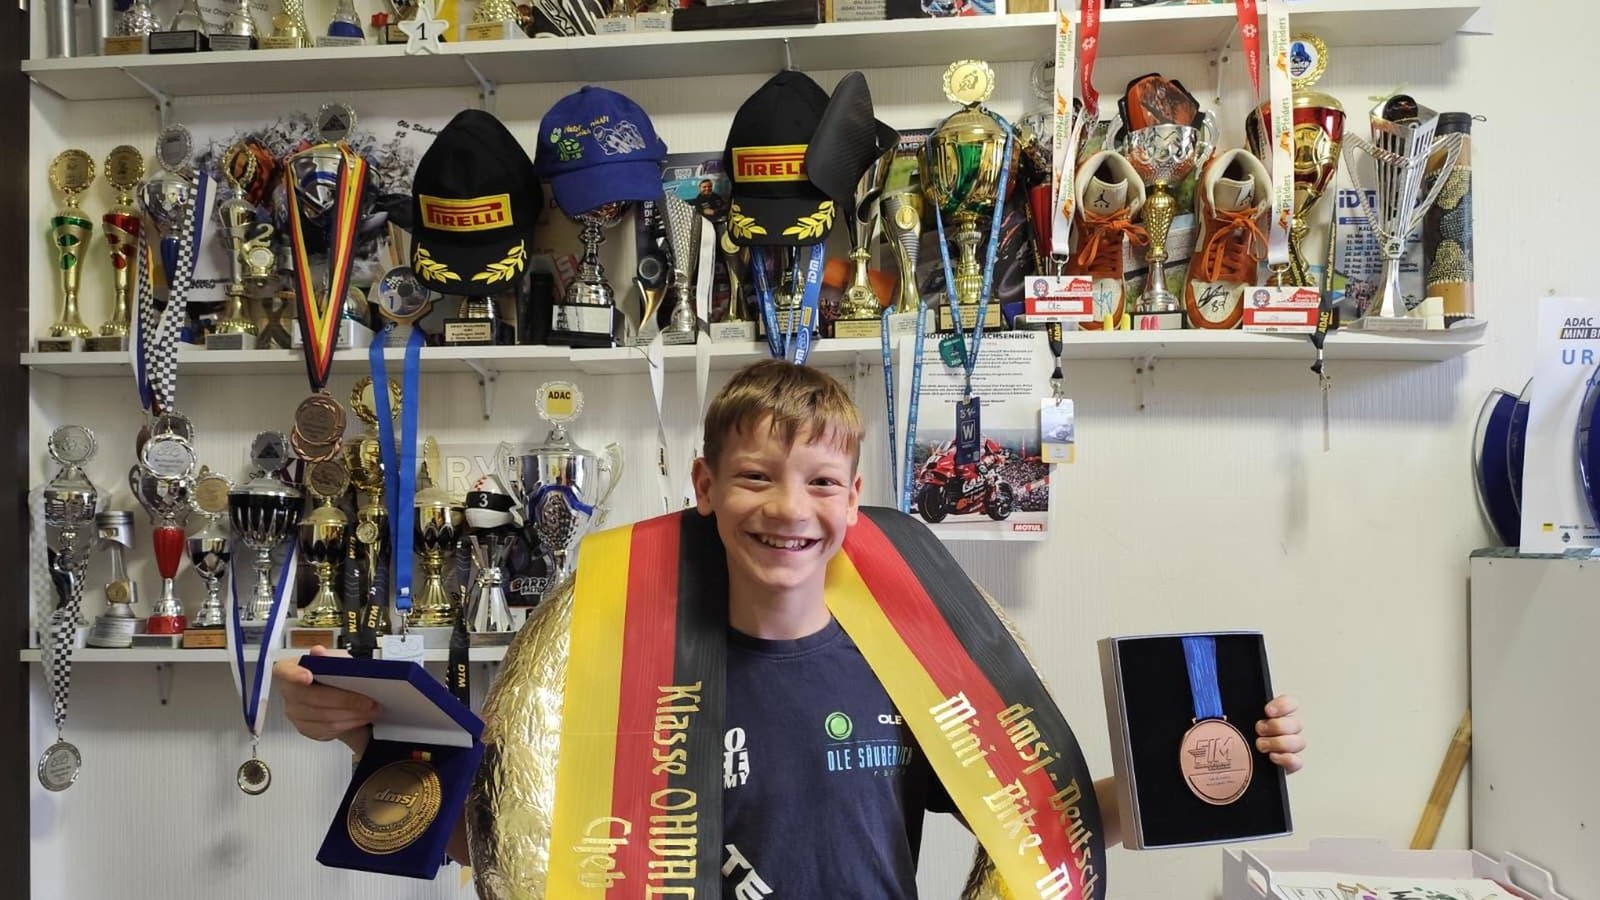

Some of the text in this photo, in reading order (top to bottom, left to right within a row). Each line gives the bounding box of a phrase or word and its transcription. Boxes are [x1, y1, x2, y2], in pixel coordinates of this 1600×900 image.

[416, 22, 428, 40] 1
[427, 201, 504, 228] PIRELLI
[1319, 312, 1329, 333] ADAC
[1564, 317, 1593, 327] ADAC
[982, 332, 1035, 340] ACHSENRING
[1563, 329, 1587, 338] MINI
[1562, 349, 1594, 365] UR
[548, 391, 571, 400] ADAC
[962, 424, 974, 440] W
[479, 494, 488, 507] 3
[348, 611, 356, 633] DTM
[368, 606, 380, 628] DTM
[457, 664, 465, 688] DTM
[652, 681, 703, 776] Klasse
[878, 714, 903, 724] OLE
[996, 704, 1060, 775] dmsj
[827, 749, 852, 771] OLE
[928, 691, 996, 767] Mini
[982, 778, 1042, 855] Bike
[374, 788, 419, 808] dmsj
[573, 816, 632, 888] Cheb
